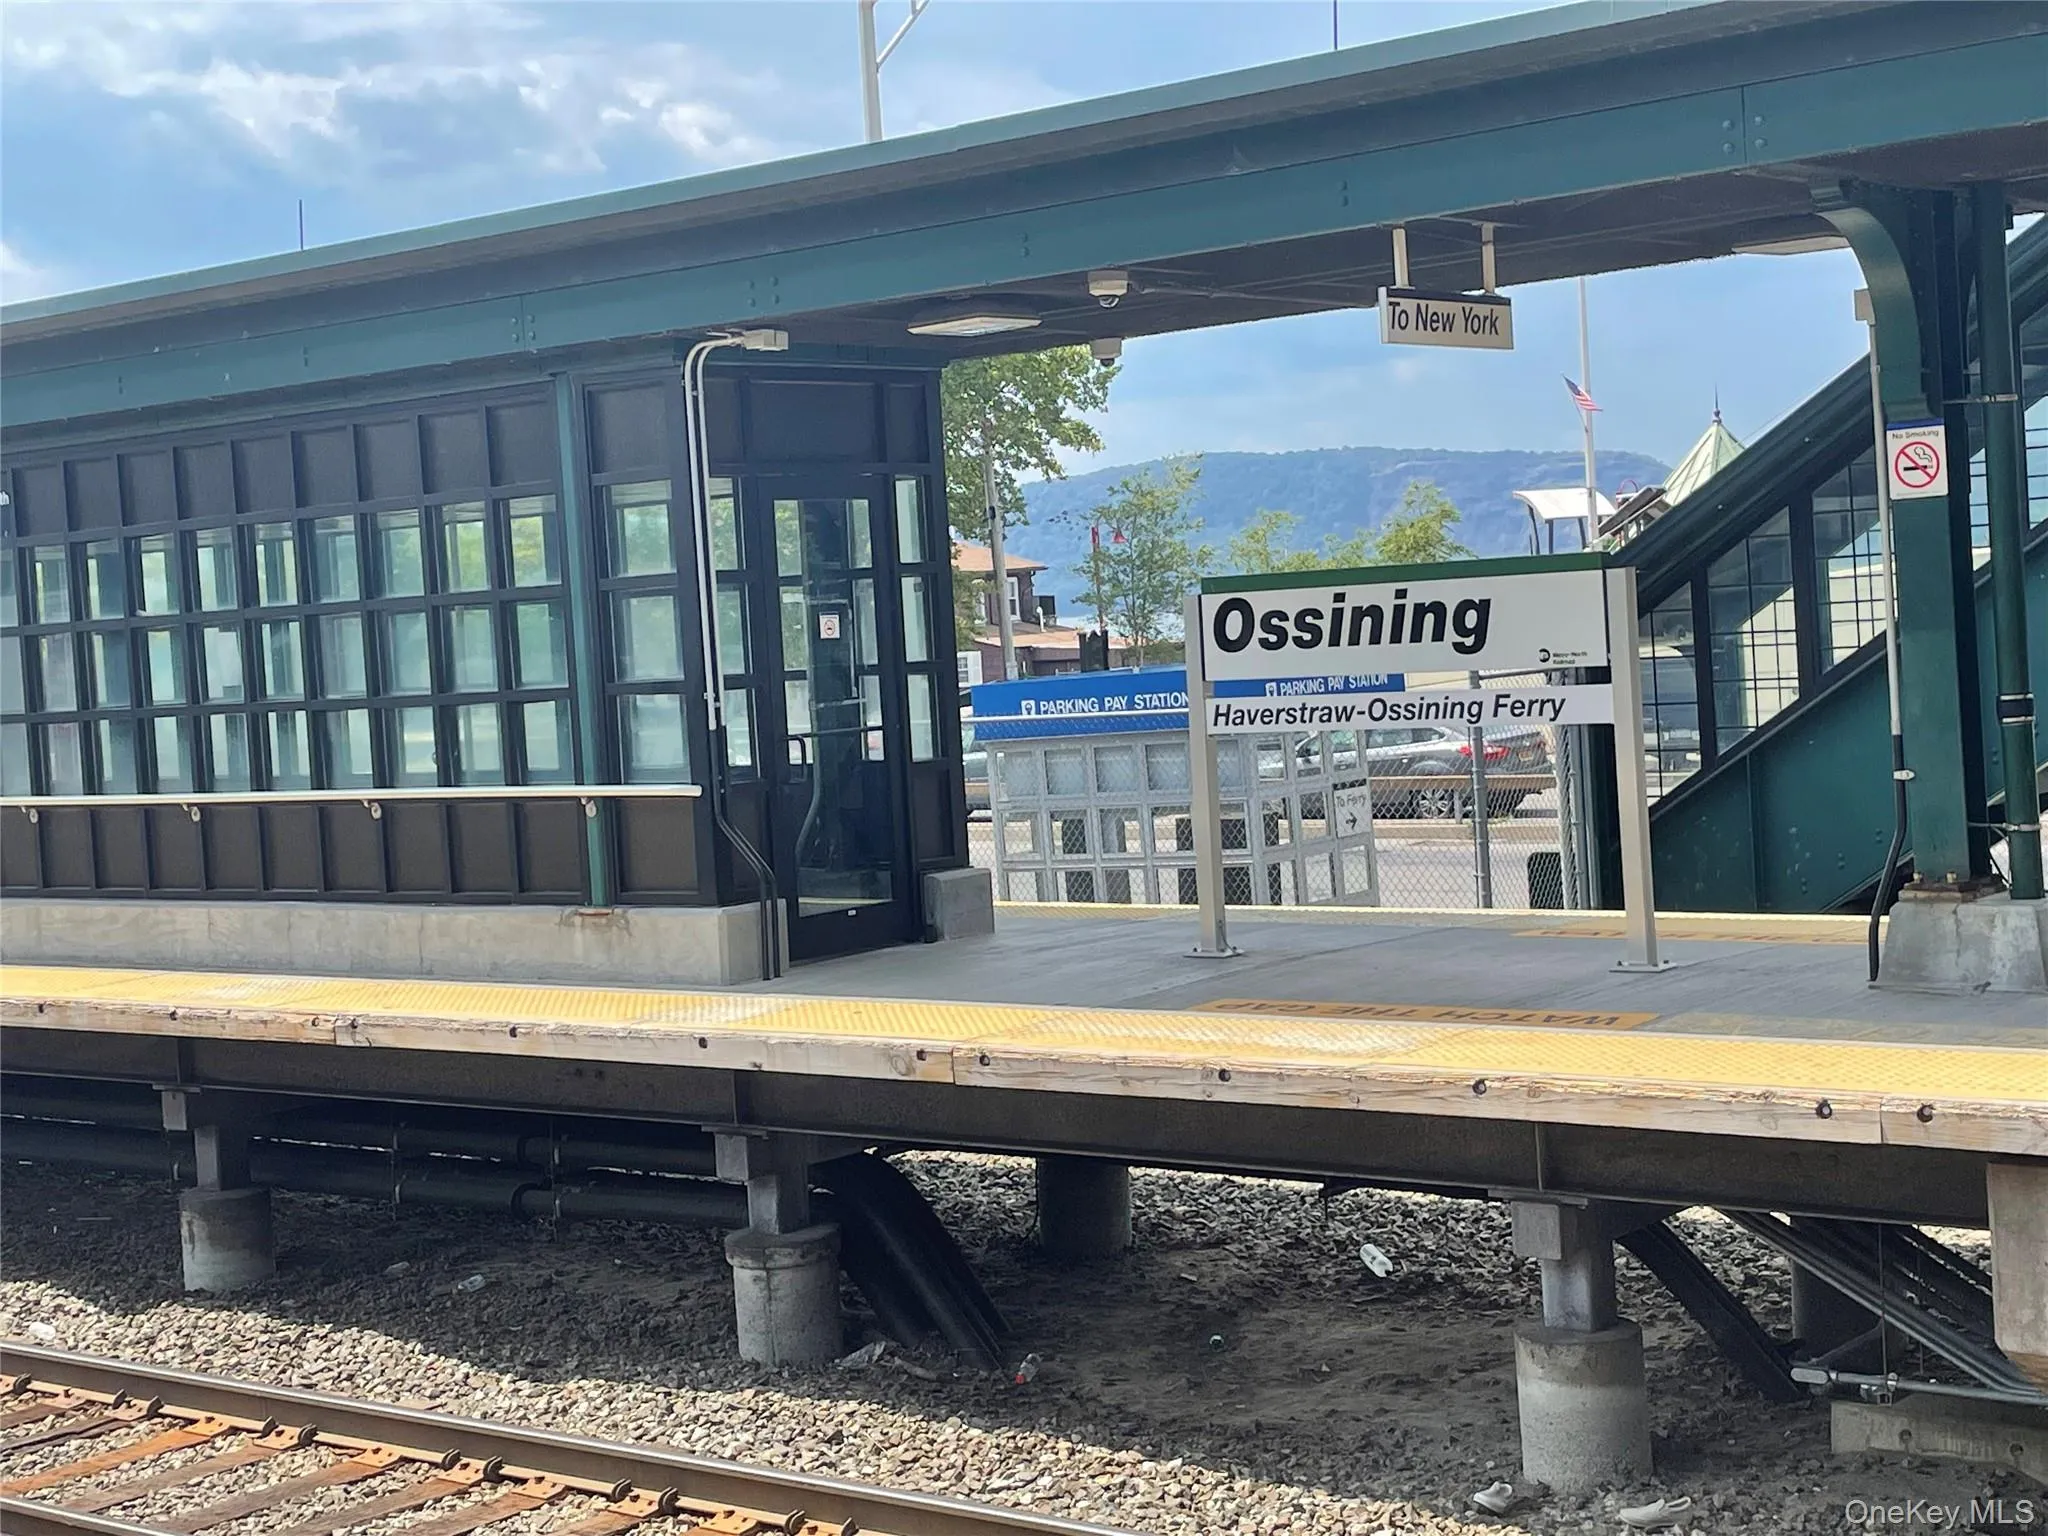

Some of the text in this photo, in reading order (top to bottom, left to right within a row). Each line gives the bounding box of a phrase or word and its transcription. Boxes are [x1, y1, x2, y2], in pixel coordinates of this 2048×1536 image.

[1389, 302, 1500, 336] To New York
[1905, 430, 1940, 439] Smoking
[1213, 588, 1492, 655] Ossining
[1280, 674, 1388, 696] PARKING PAY STATION
[1039, 691, 1189, 715] PARKING PAY STATION
[1213, 693, 1566, 725] Haverstraw-Ossining Ferry
[1216, 1003, 1620, 1026] WATCH THE GAP
